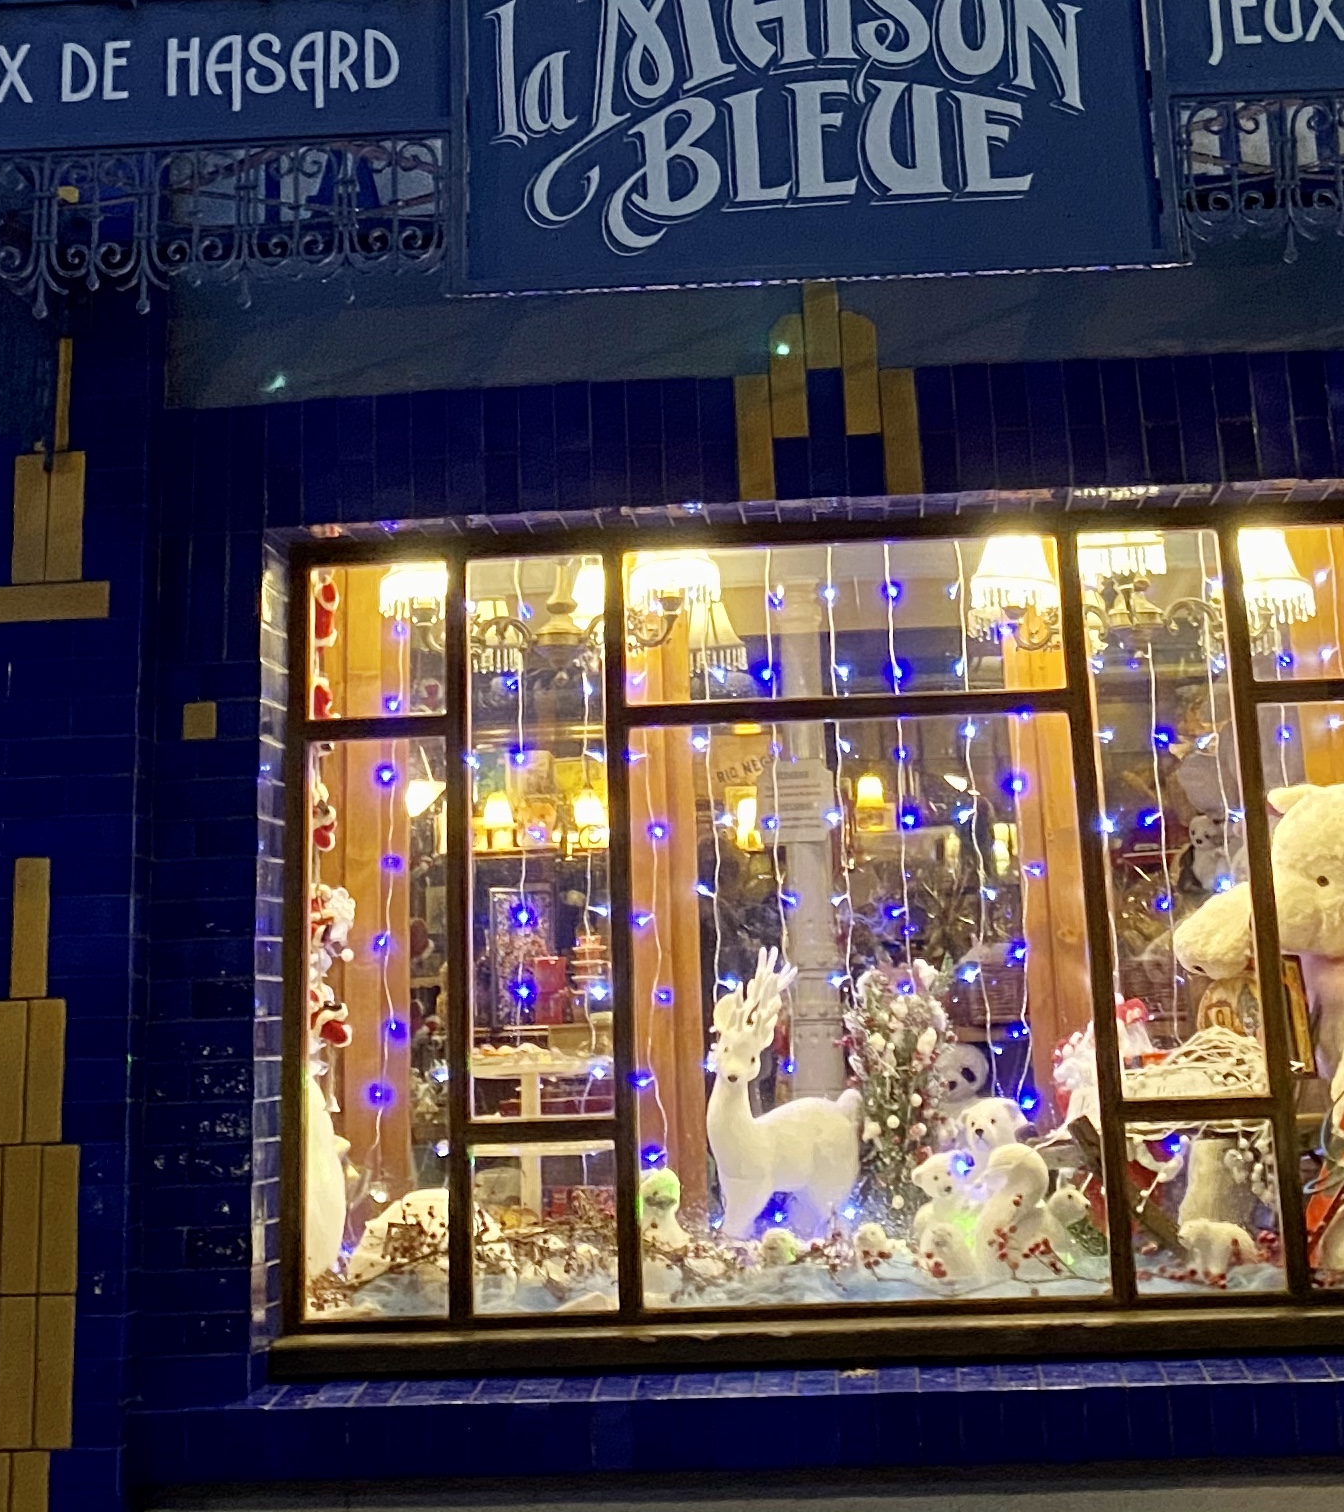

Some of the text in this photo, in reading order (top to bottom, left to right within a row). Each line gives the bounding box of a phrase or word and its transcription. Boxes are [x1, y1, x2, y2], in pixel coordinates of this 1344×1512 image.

[61, 40, 131, 102] DE
[167, 28, 400, 112] HASARD
[483, 0, 579, 148] la
[602, 78, 1034, 256] BLEUE
